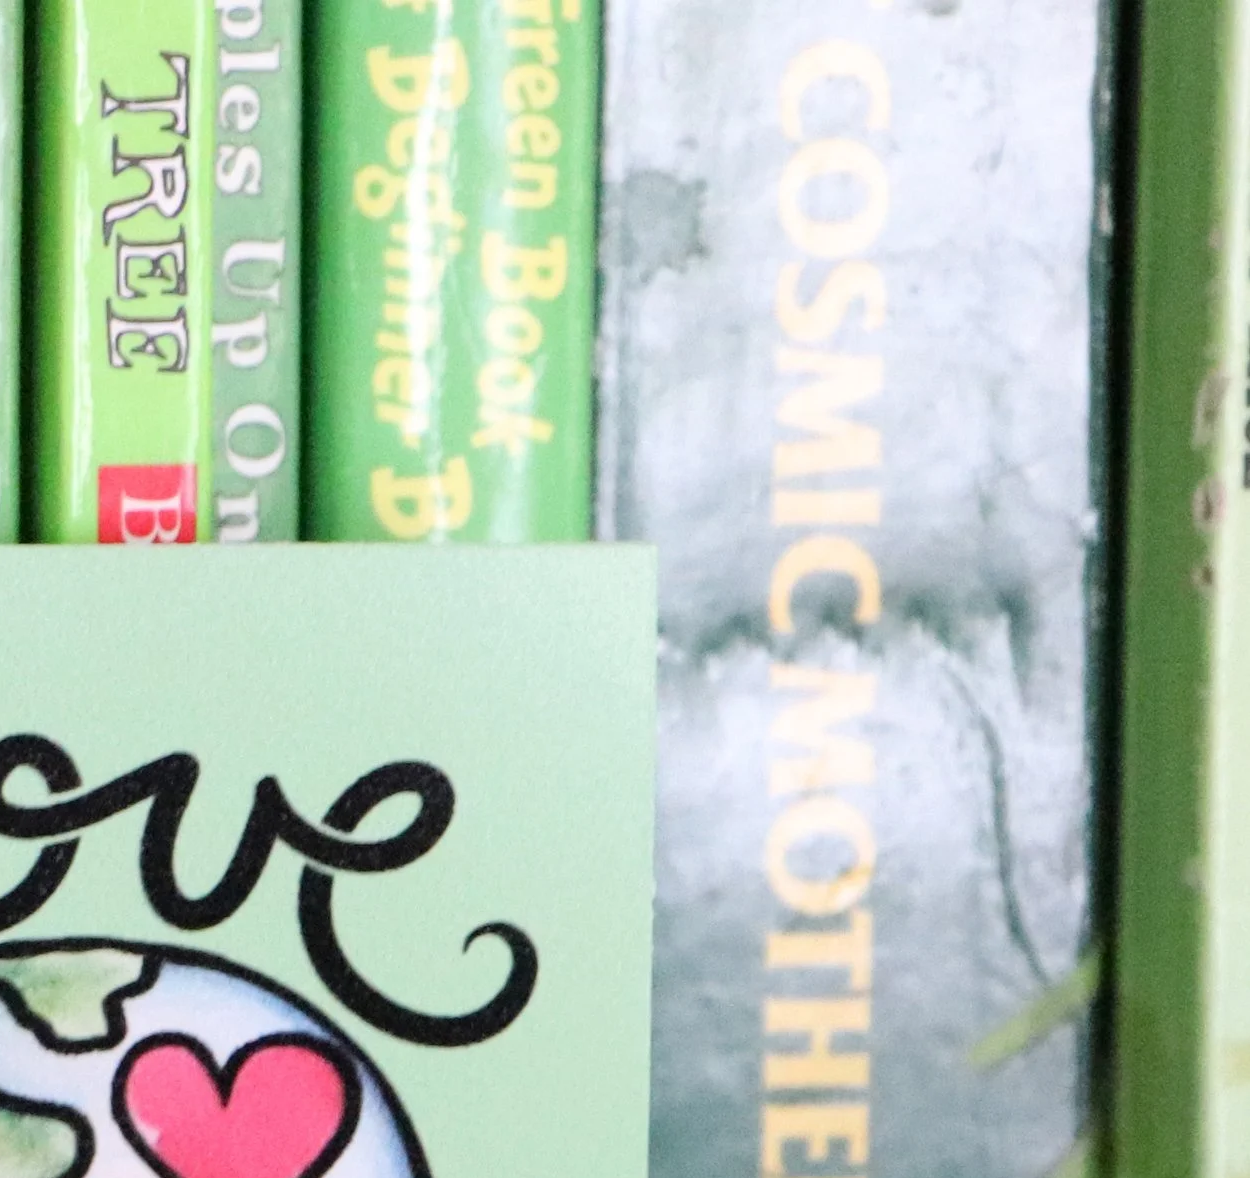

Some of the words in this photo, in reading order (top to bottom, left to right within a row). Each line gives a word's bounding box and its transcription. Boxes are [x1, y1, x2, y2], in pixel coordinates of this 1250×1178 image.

[101, 51, 190, 374] TREE
[212, 238, 286, 368] Up
[353, 37, 470, 450] Beginner
[470, 230, 567, 455] Book
[768, 37, 891, 634] COSMIC
